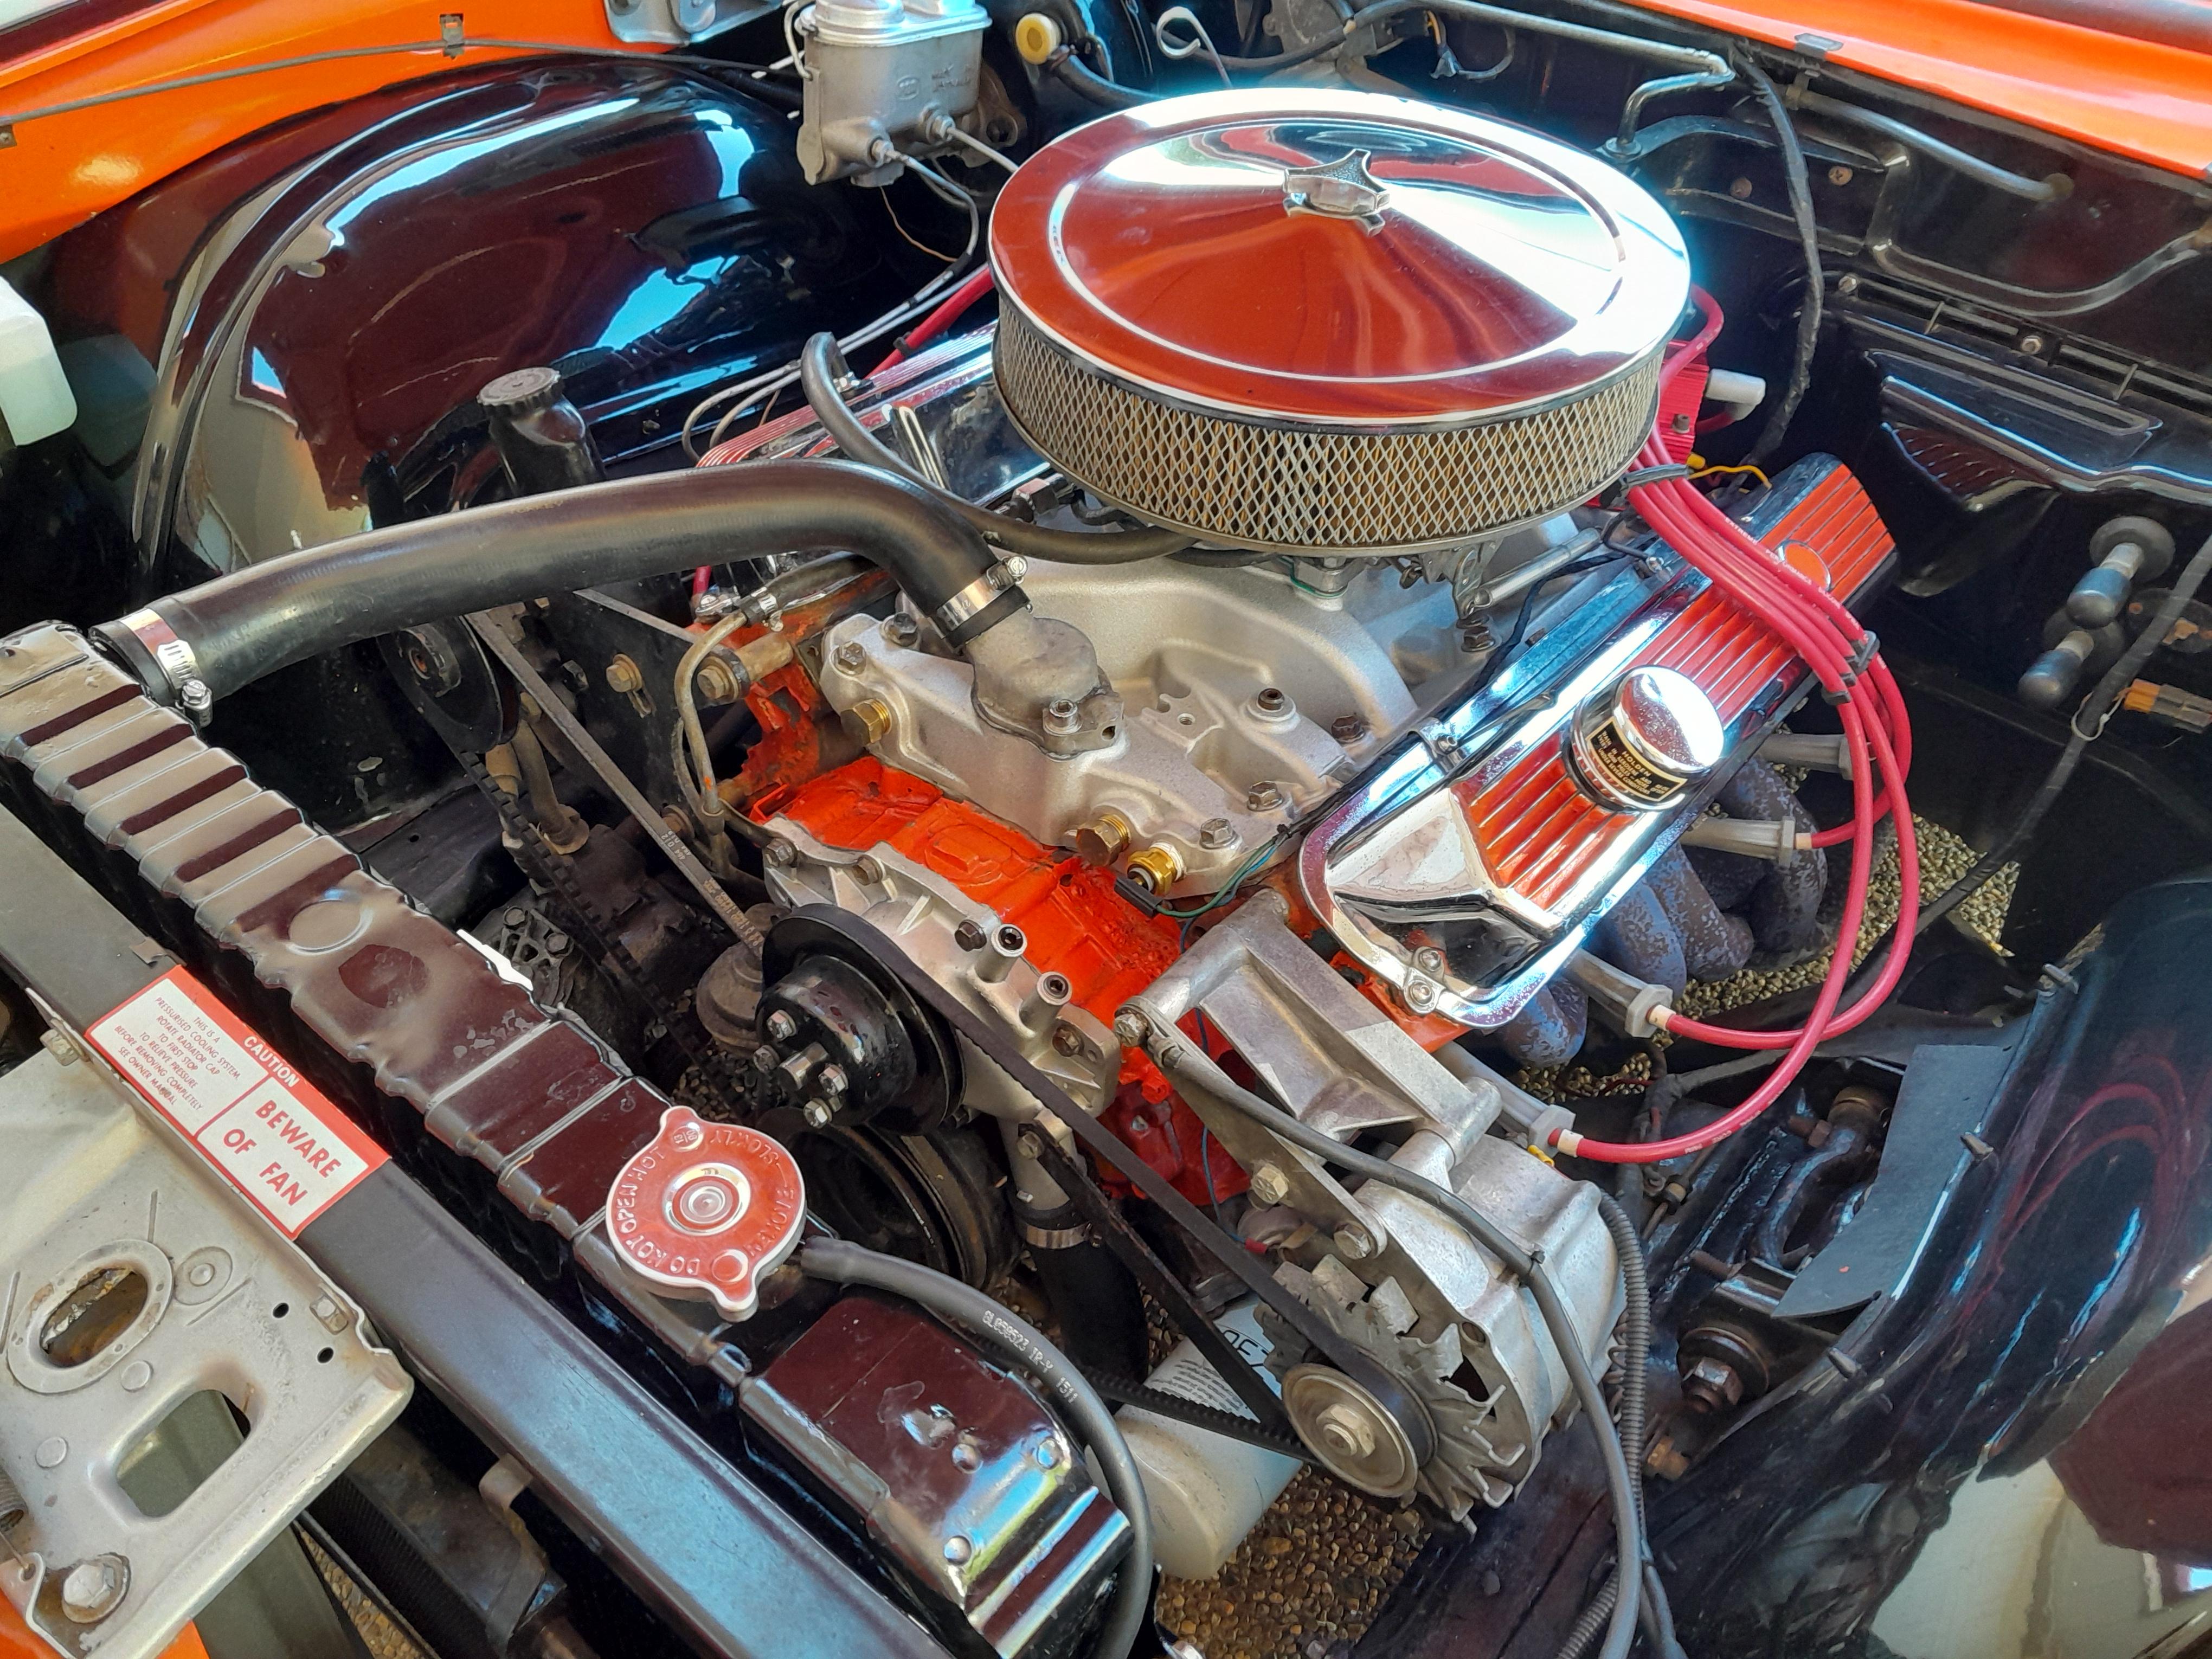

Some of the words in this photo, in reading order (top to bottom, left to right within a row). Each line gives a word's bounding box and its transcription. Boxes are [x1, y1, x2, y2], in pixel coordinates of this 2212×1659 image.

[1598, 748, 1610, 764] UNDER
[1608, 762, 1624, 778] SEVERE
[1622, 776, 1650, 795] CONDITIONS
[1616, 755, 1639, 776] KEROSENE
[1640, 776, 1652, 785] AND
[1617, 764, 1630, 776] MILES
[1634, 778, 1649, 788] MORE
[1621, 750, 1651, 777] HOLDEN
[155, 996, 191, 1032] PRESSURISED
[190, 1030, 219, 1058] COOLING
[156, 1015, 178, 1037] ROTATE
[177, 1035, 206, 1064] RADIATOR
[205, 1062, 220, 1076] CAP
[193, 1017, 208, 1031] THIS
[206, 1029, 215, 1038] IS
[114, 1025, 137, 1046] BEFORE
[134, 1045, 168, 1077] REMOVING
[166, 1076, 203, 1111] COMPLETELY
[118, 1046, 130, 1058] SEE
[128, 1056, 152, 1079] OWNER
[139, 1032, 150, 1043] TO
[148, 1040, 172, 1063] RELIEVE
[170, 1061, 198, 1089] PRESSURE
[158, 1033, 169, 1044] TO
[166, 1041, 183, 1058] FIRST
[182, 1057, 198, 1072] STOP
[243, 1035, 299, 1088] CAUTION
[255, 1099, 341, 1178] BEWARE
[673, 1134, 684, 1143] 13
[222, 1128, 255, 1156] OF
[259, 1163, 308, 1206] FAN
[627, 1146, 665, 1180] HOT
[616, 1184, 638, 1232] OPEN
[627, 1234, 666, 1268] NOT
[670, 1256, 699, 1275] DO
